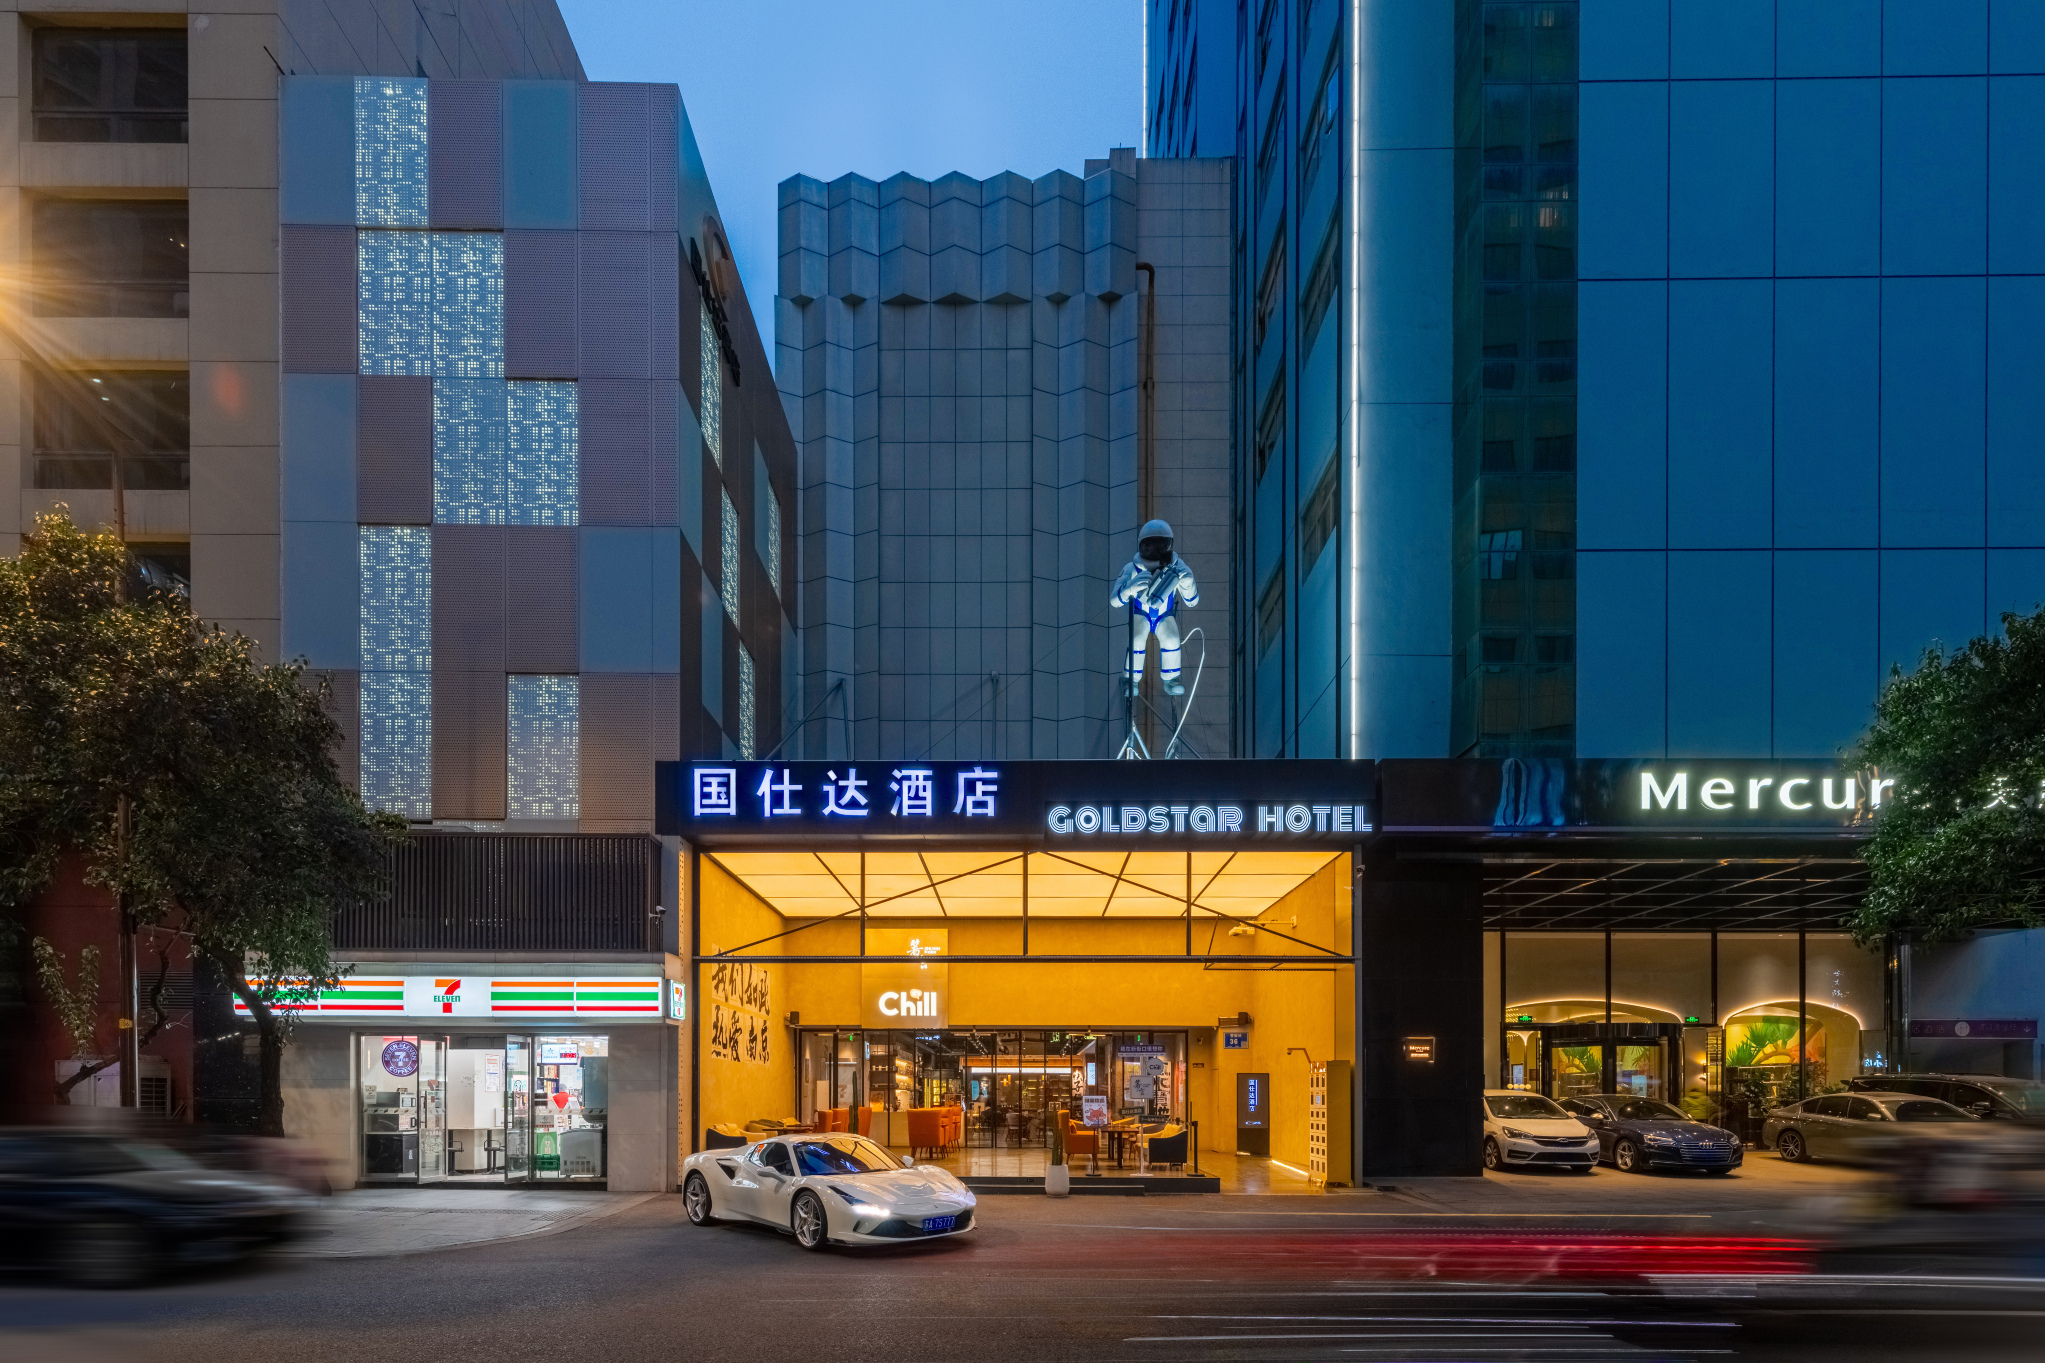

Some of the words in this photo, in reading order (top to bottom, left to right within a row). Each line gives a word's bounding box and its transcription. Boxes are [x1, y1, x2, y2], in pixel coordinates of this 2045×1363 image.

[693, 766, 998, 818] 国仕达酒店
[1641, 772, 1932, 810] Mercur
[1048, 806, 1243, 833] GOLDSTAR
[1258, 805, 1373, 833] HOTEL
[879, 990, 937, 1016] Chill
